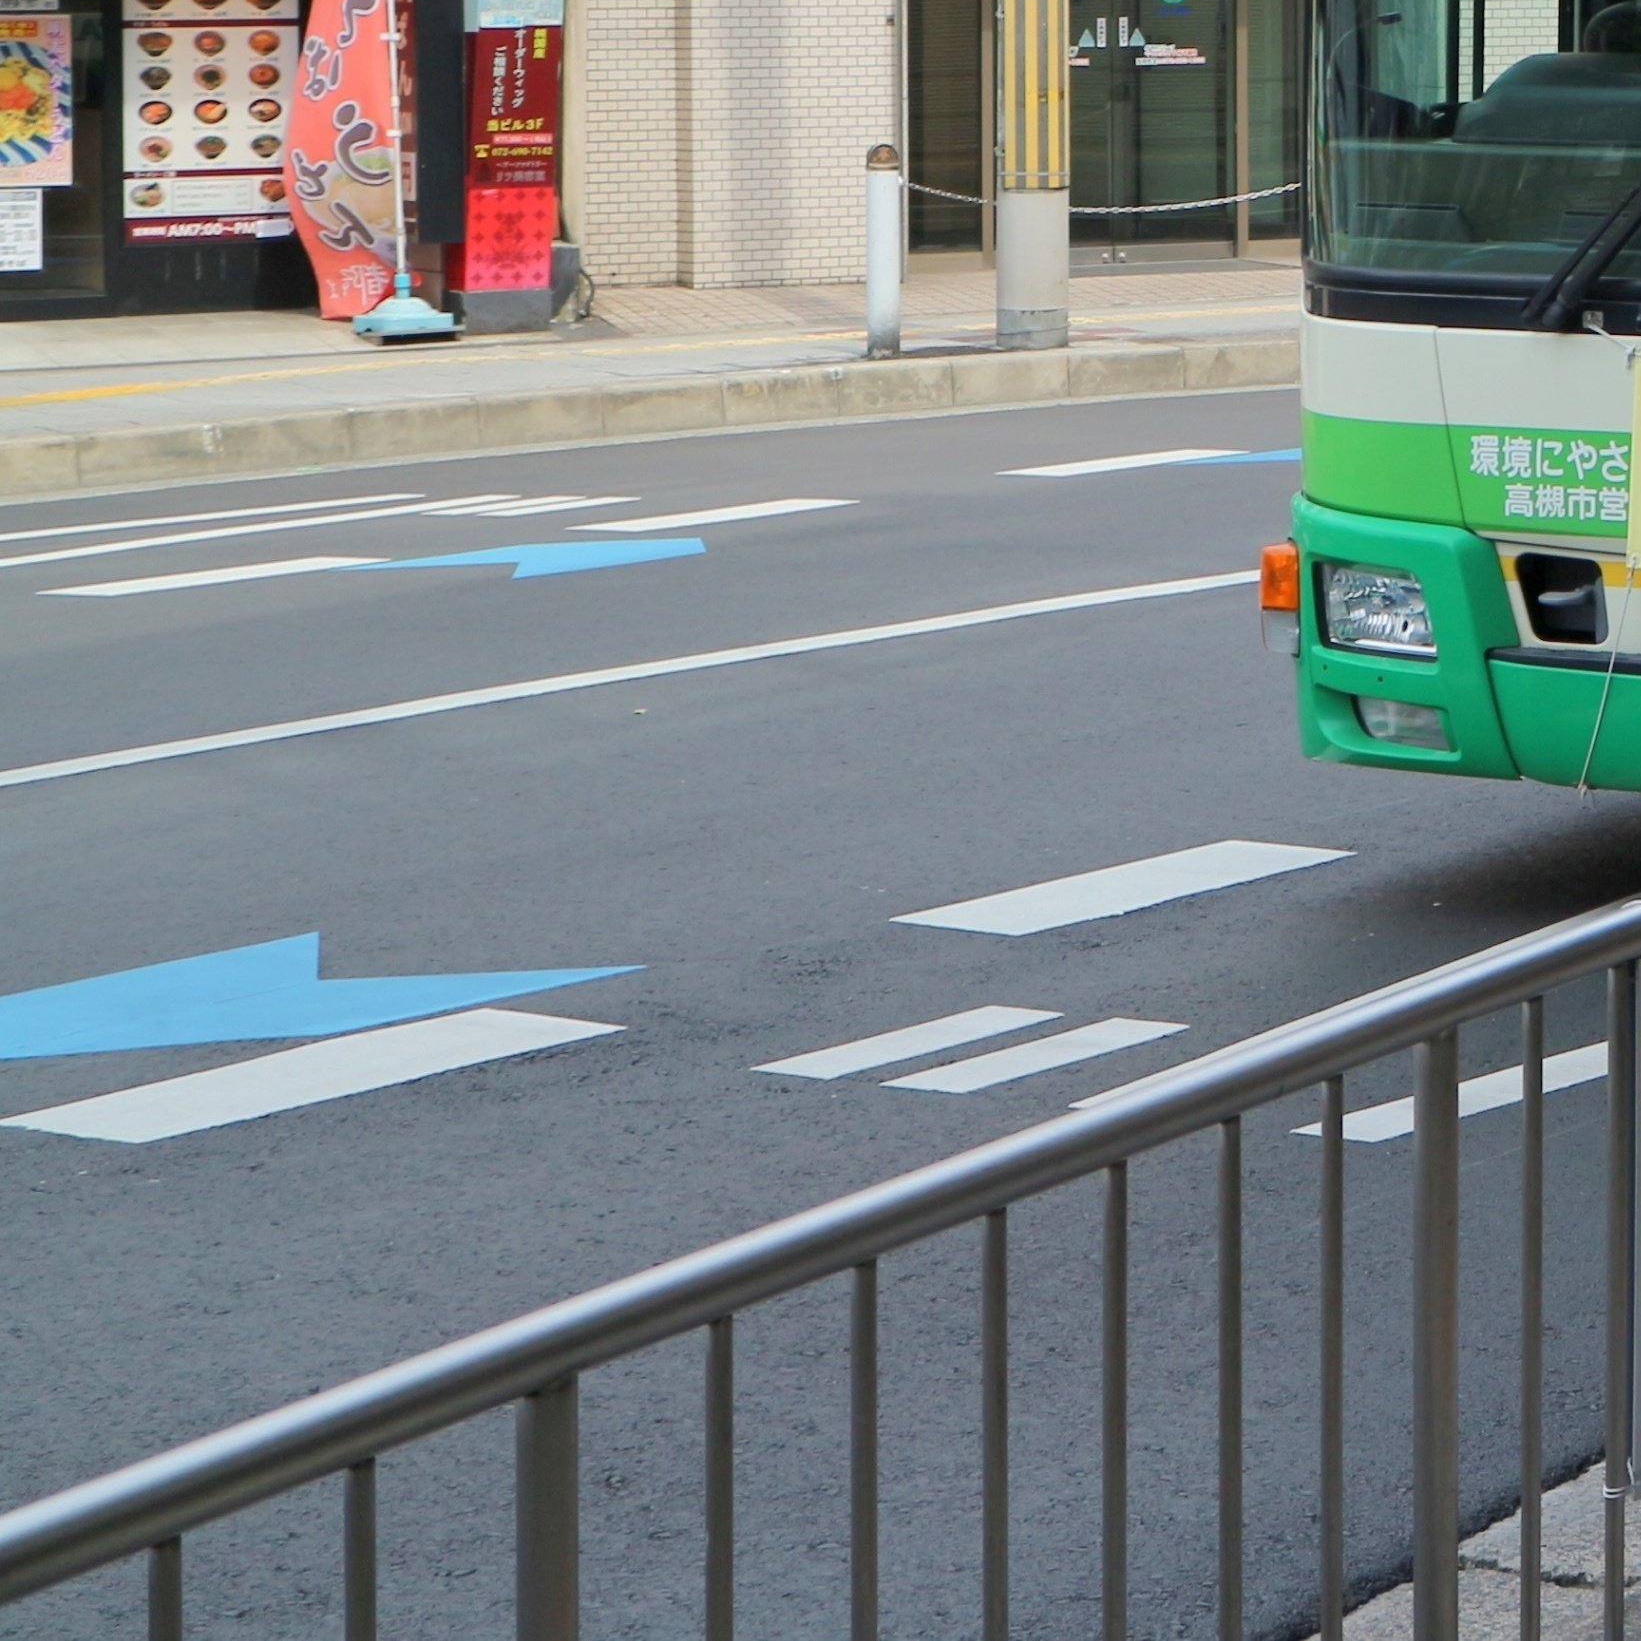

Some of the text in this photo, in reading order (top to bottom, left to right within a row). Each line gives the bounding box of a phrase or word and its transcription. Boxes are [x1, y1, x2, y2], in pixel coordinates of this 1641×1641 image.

[1469, 435, 1632, 484] 環境にやさ
[1503, 484, 1630, 522] 高槻市営
